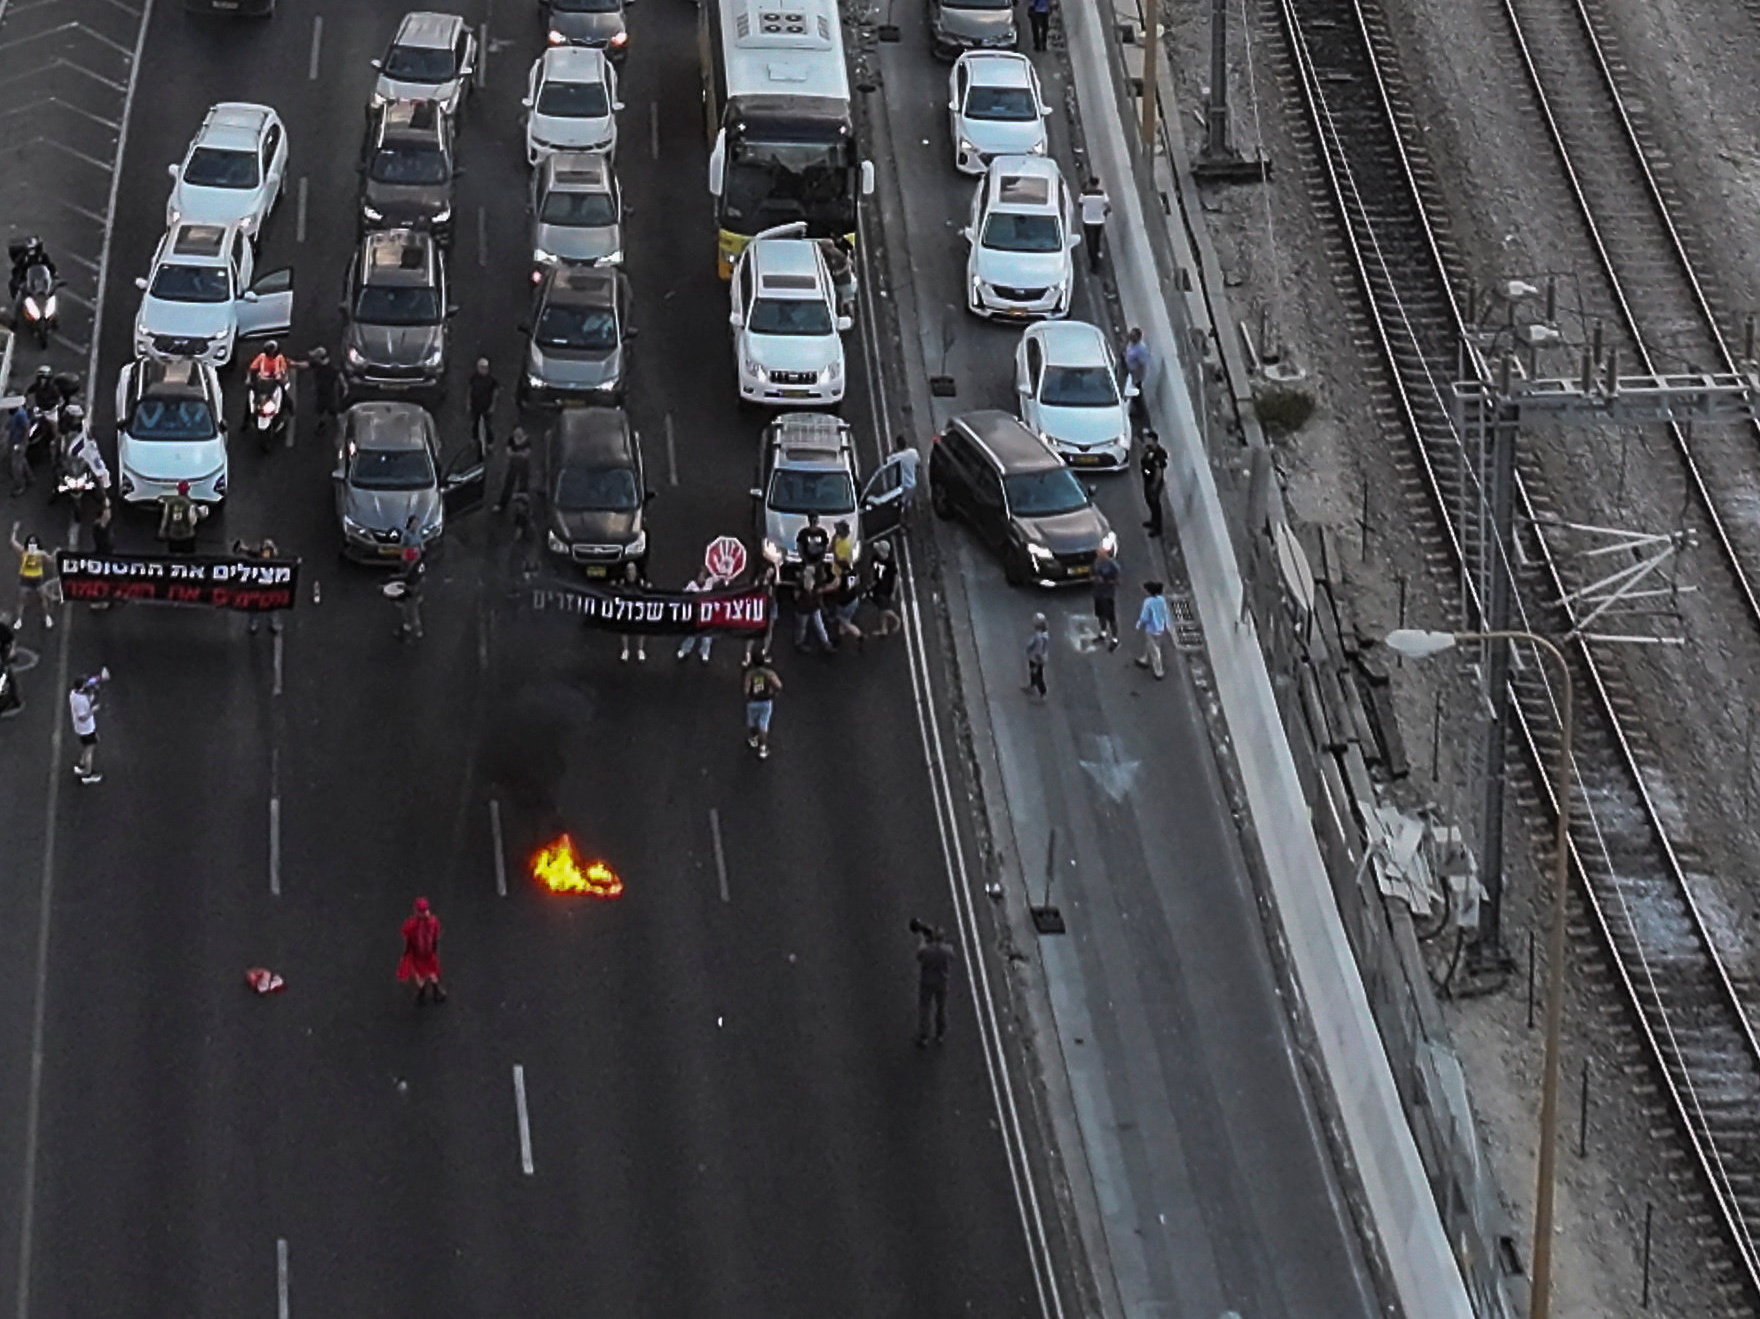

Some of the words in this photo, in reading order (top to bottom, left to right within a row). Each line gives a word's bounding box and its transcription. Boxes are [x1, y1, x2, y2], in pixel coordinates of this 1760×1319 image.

[62, 558, 164, 577] החטופים
[170, 563, 204, 579] את
[213, 563, 290, 585] מצילים
[601, 596, 664, 621] שכולם
[670, 602, 692, 621] עד
[700, 598, 765, 623] עוצרים
